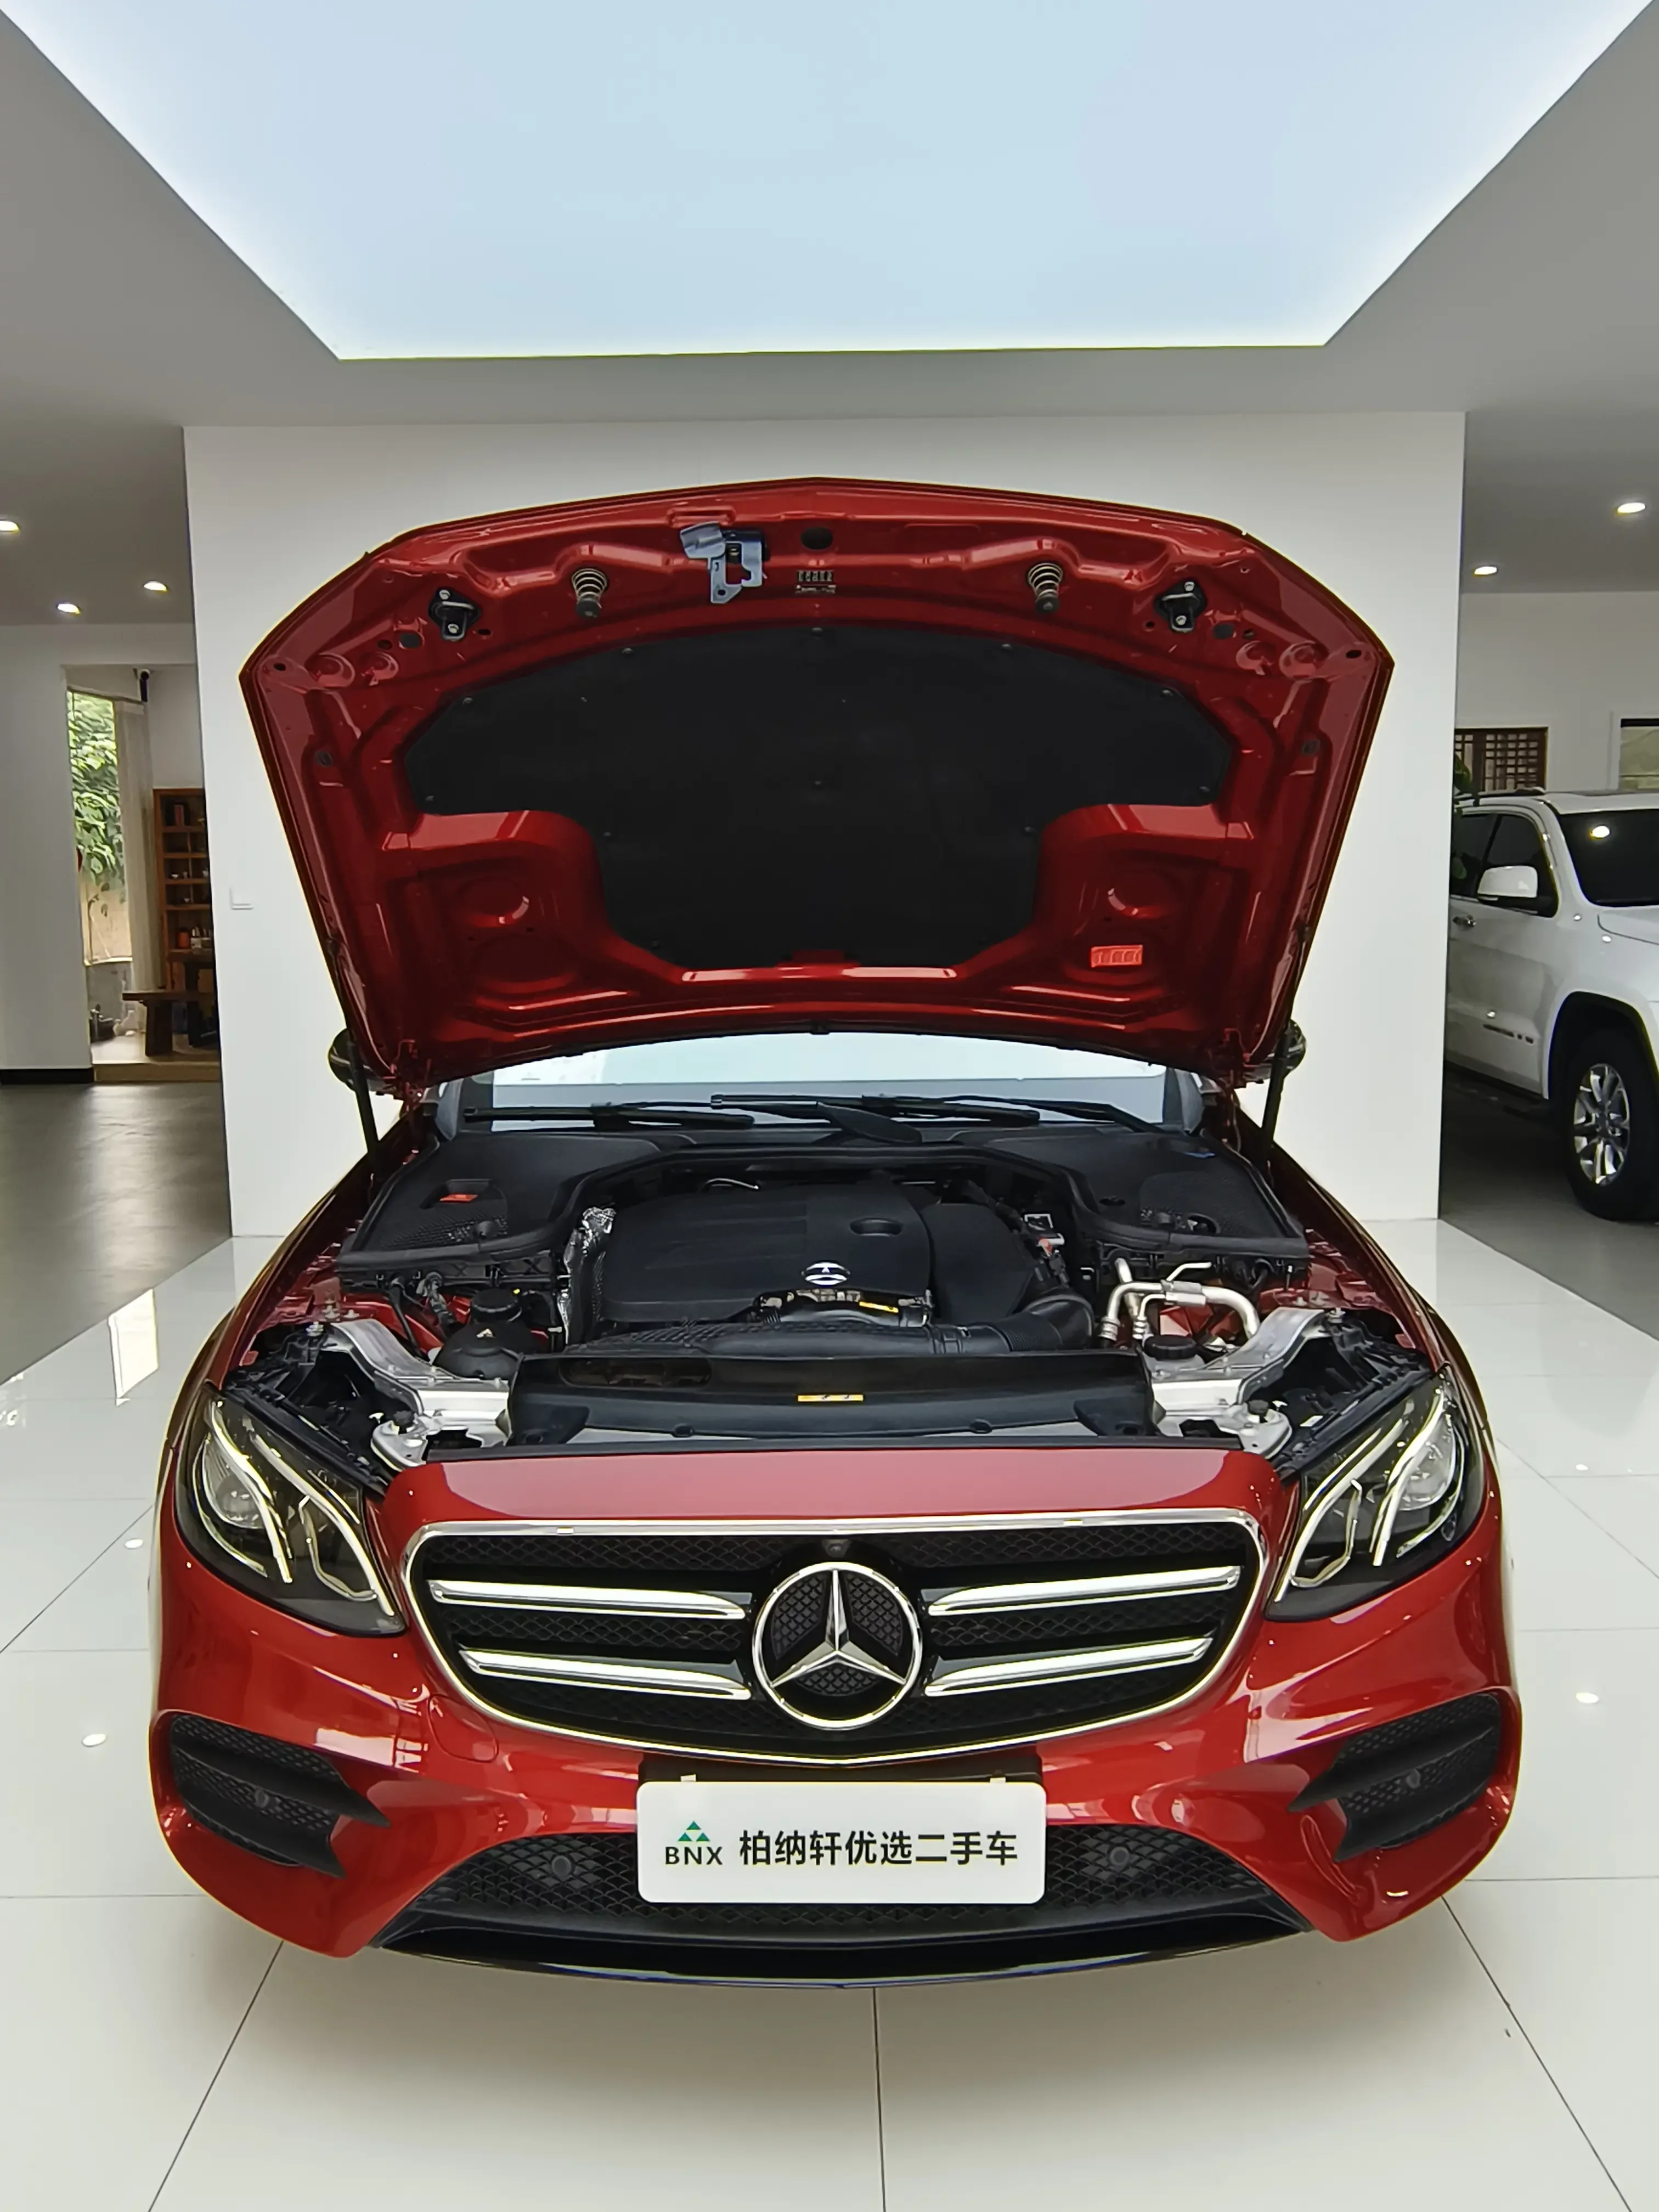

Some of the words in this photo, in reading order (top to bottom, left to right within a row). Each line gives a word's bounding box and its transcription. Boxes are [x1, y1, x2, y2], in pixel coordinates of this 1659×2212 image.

[665, 1846, 723, 1865] BNX
[739, 1830, 1018, 1866] 柏纳轩优选二手车
